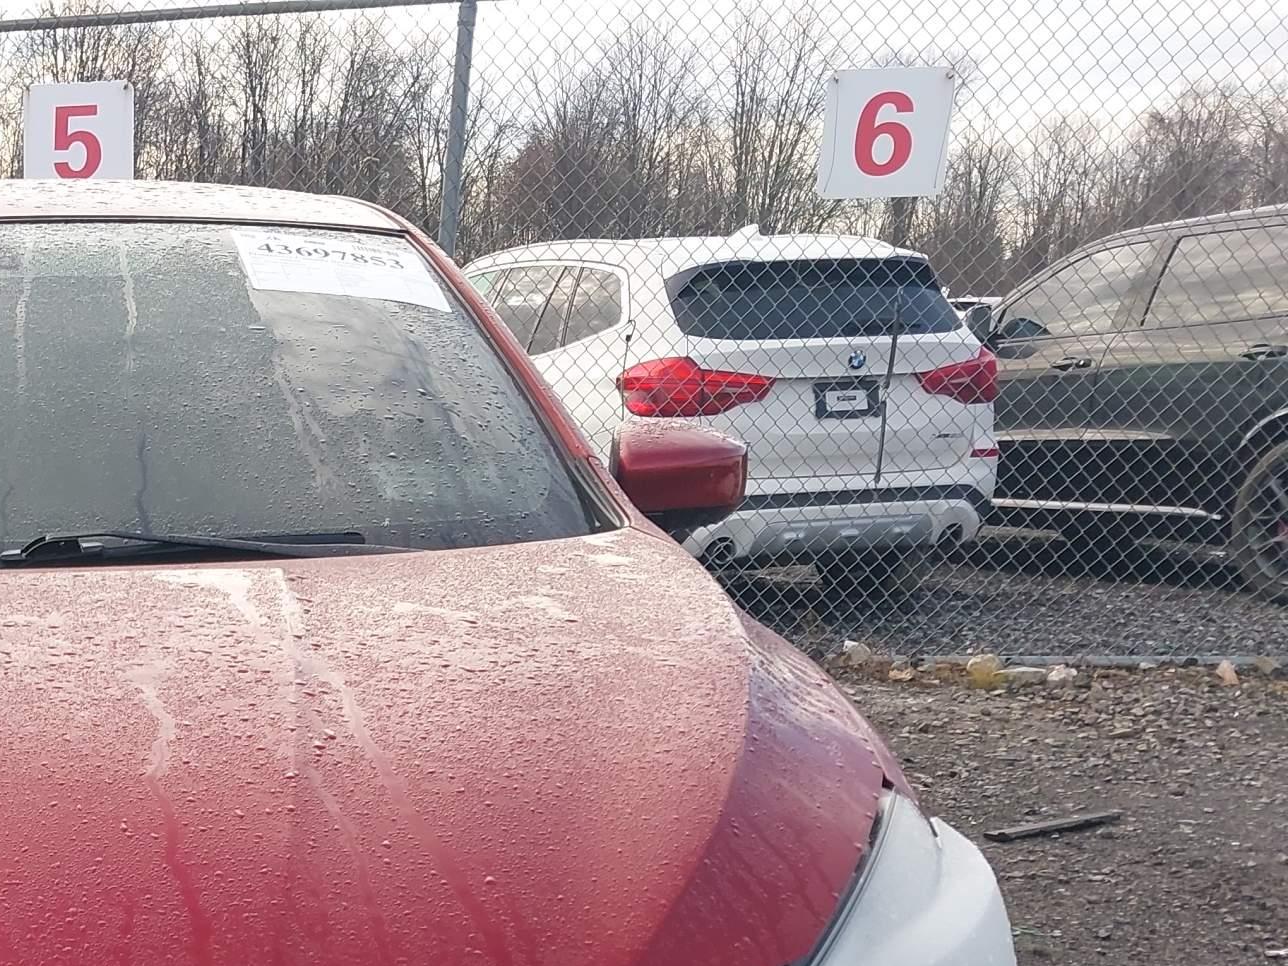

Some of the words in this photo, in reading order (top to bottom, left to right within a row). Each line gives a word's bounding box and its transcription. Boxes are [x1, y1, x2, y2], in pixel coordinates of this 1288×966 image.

[53, 104, 102, 179] 5
[854, 90, 914, 177] 6
[257, 243, 405, 269] 43697853
